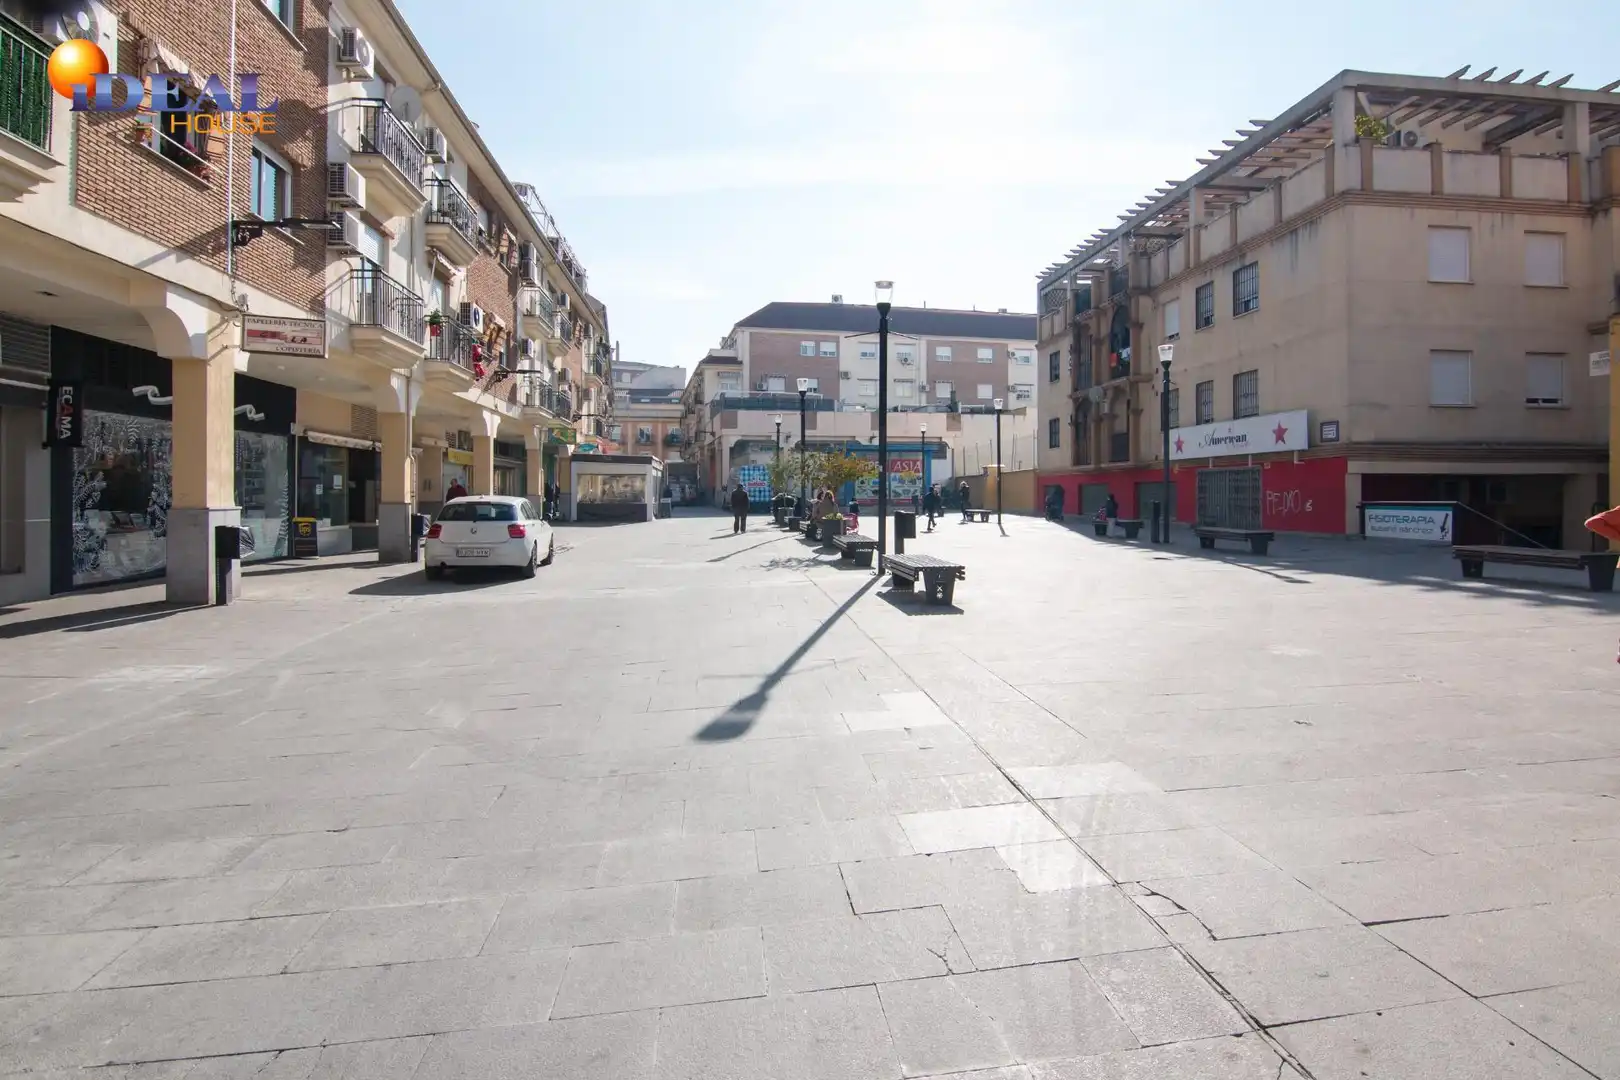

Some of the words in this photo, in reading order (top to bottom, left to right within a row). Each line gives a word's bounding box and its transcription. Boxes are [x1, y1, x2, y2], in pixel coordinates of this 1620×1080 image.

[1198, 428, 1247, 449] American
[893, 460, 921, 473] ASIA
[1368, 512, 1436, 525] FISIOTERAPIA
